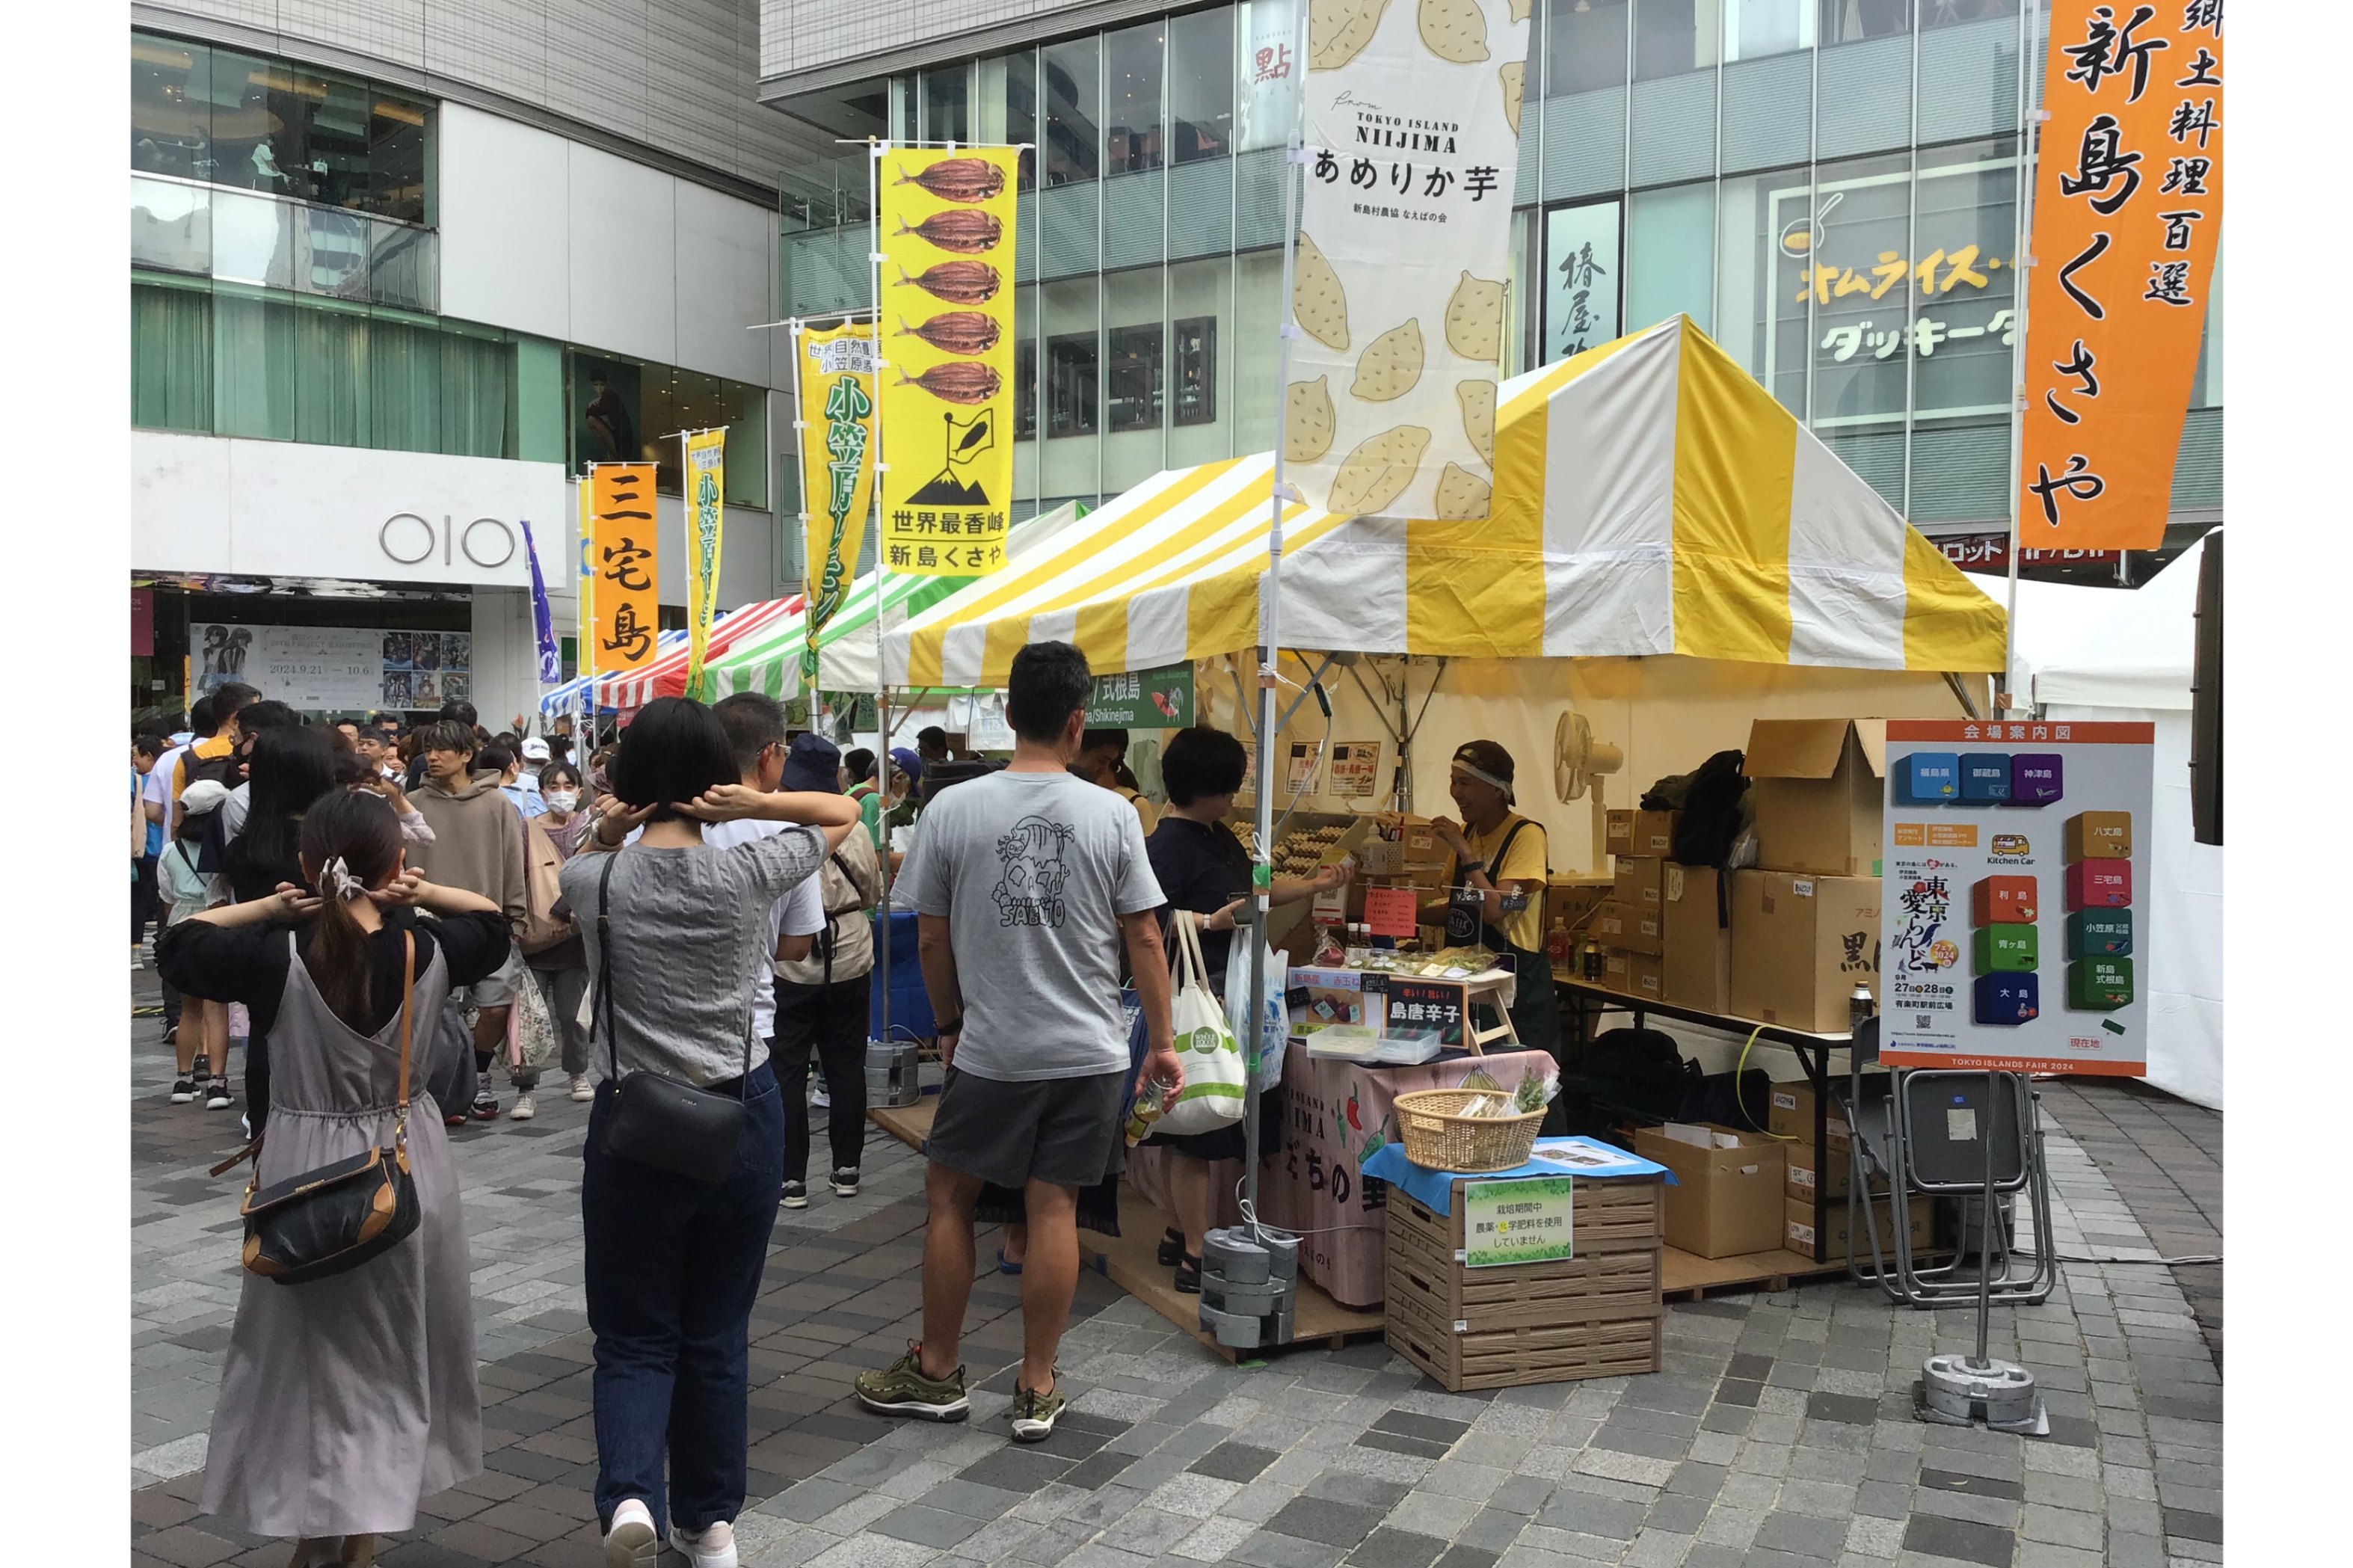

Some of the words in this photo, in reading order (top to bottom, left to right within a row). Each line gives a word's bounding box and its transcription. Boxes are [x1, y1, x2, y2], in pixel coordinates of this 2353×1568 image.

[1357, 112, 1402, 127] TOKYO
[1408, 119, 1459, 132] ISLAND
[1356, 126, 1457, 154] NIIJIMA
[1315, 149, 1499, 202] あめりか芋
[1353, 203, 1400, 219] 新島村農協
[1403, 209, 1448, 224] なえばの会
[2029, 4, 2168, 528] 新島くさや
[1796, 244, 2016, 306] オムライス・
[892, 510, 1003, 535] 世界最香峰
[890, 544, 1000, 568] 新島くさや
[1937, 540, 2003, 563] ロット
[600, 475, 653, 662] 三宅島
[1964, 725, 2071, 740] 会場案内図
[2023, 769, 2052, 779] 神津島
[1987, 857, 2019, 865] Kitchen
[2020, 858, 2036, 866] Car
[2094, 875, 2123, 885] 三宅島
[1924, 876, 1950, 923] 東京
[1999, 891, 2027, 900] 利島
[1855, 908, 1881, 918] アミノ
[2085, 923, 2114, 933] 小笠原
[1841, 931, 1881, 973] 黒
[1934, 951, 1954, 959] 2024
[2096, 965, 2114, 974] 新島
[2096, 975, 2124, 985] 式根島
[2000, 989, 2028, 999] 大島
[1895, 1000, 1953, 1010] 有楽町駅前広場
[1390, 1002, 1460, 1023] 島唐辛子
[2070, 1038, 2100, 1048] 現在地
[1951, 1058, 1981, 1067] TOKYO
[1982, 1059, 2024, 1069] ISLANDS
[2025, 1060, 2049, 1069] FAIR
[2051, 1062, 2074, 1071] 2024
[1496, 1202, 1542, 1215] 栽培期間中
[1476, 1217, 1562, 1234] 農薬・化学肥料を使用
[1494, 1235, 1545, 1248] していません
